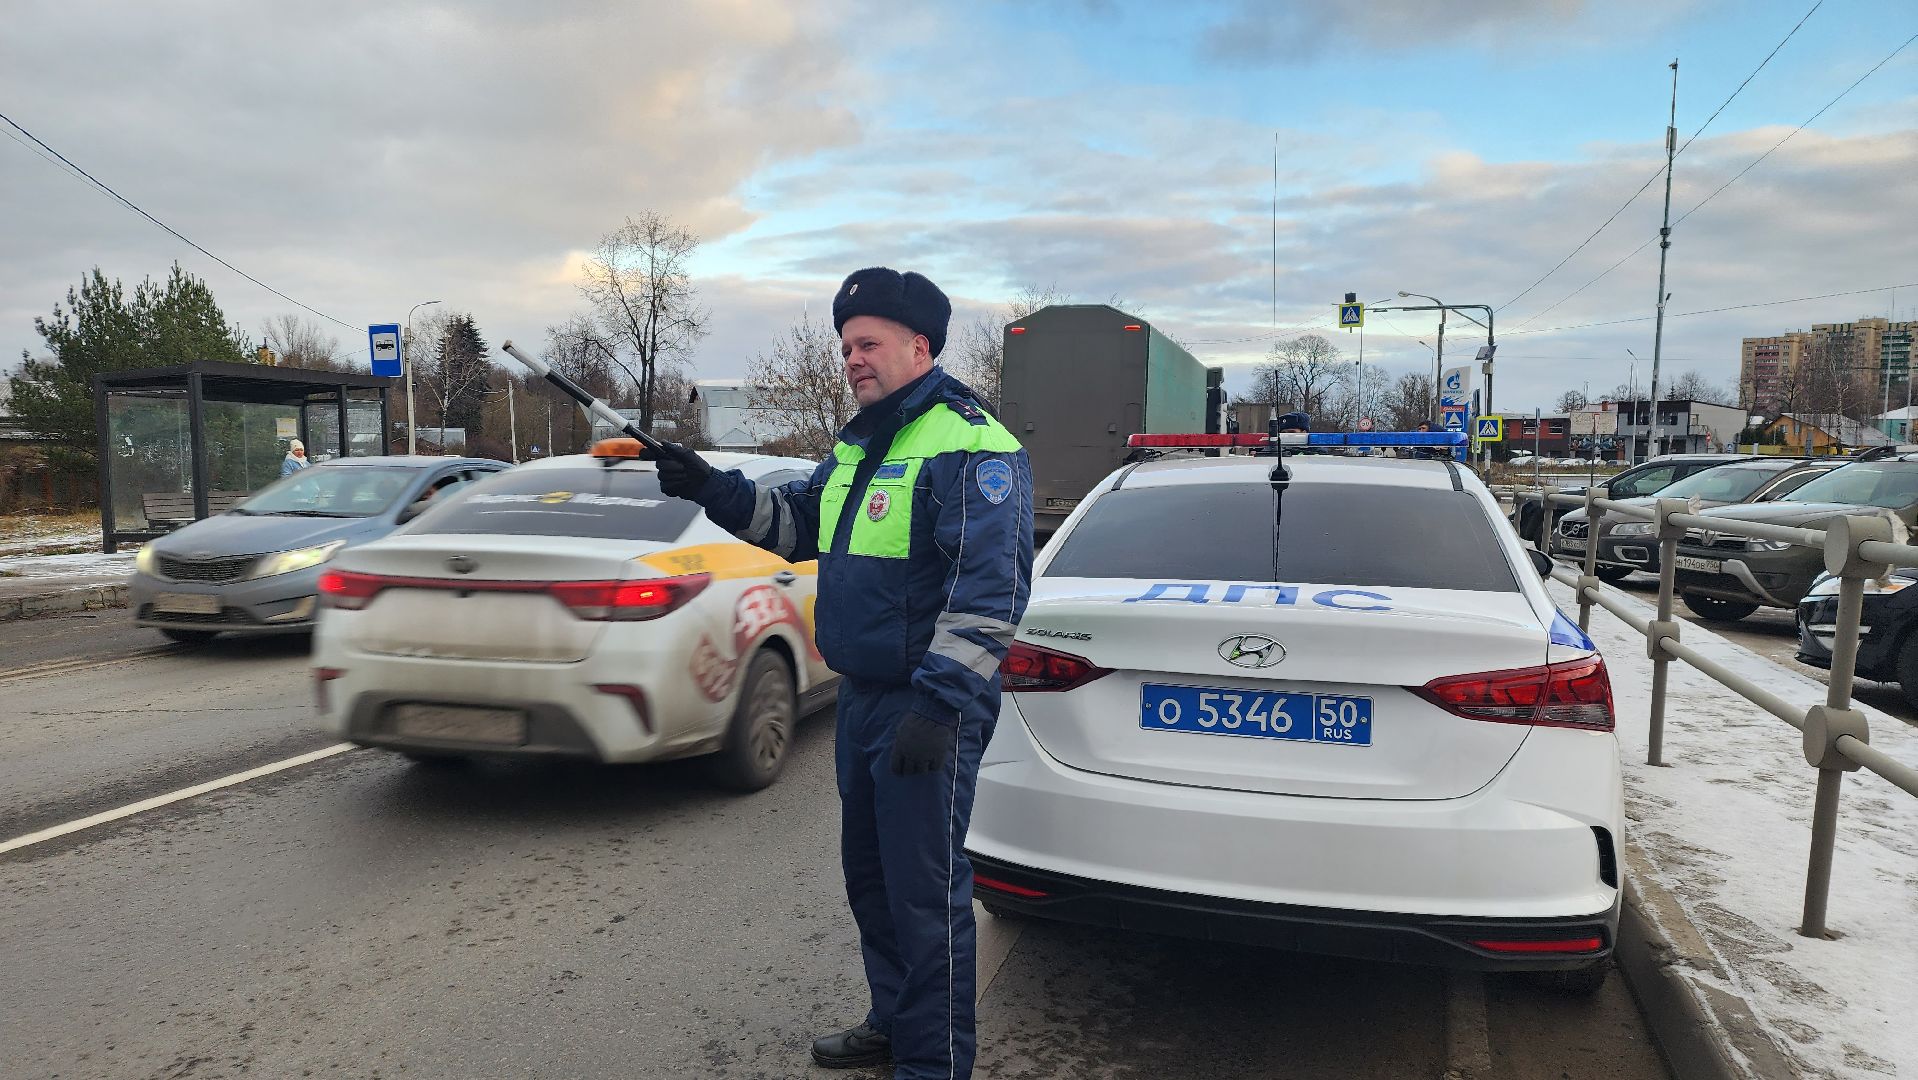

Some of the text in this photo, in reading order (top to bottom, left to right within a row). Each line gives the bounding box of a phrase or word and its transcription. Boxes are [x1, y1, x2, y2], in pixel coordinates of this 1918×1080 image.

[1121, 583, 1394, 611] ДПС
[1025, 627, 1093, 641] SOLARIS
[1158, 692, 1358, 733] О 5346 50
[1323, 727, 1352, 740] RUS
